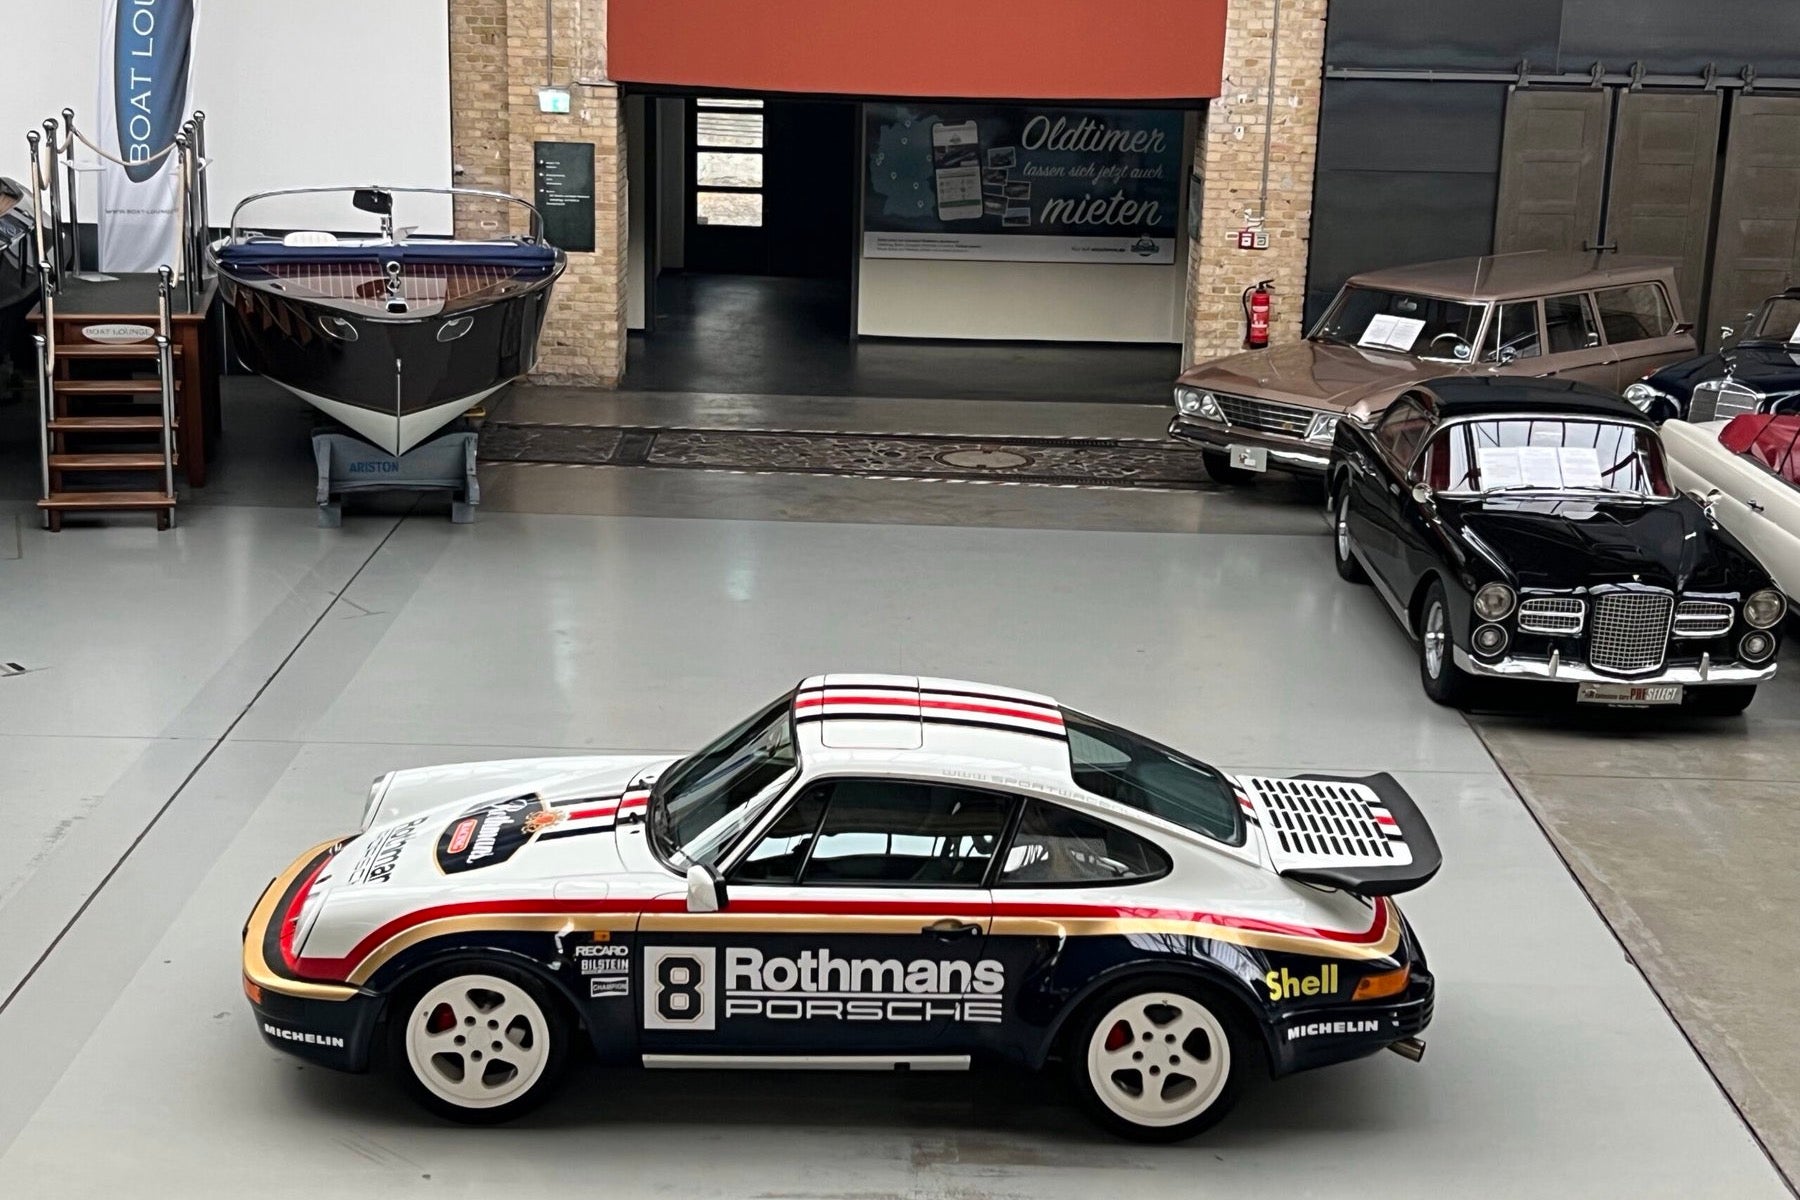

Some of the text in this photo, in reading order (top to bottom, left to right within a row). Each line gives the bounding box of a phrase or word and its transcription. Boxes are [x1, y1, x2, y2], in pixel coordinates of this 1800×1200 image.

[129, 67, 152, 164] BOAT
[1021, 115, 1166, 153] Oldtimer
[1023, 161, 1164, 185] lassen sich jetzt auch
[1040, 189, 1162, 226] mieten
[350, 461, 399, 473] ARISTON
[575, 945, 629, 957] RECARO
[581, 958, 629, 972] BILSTEIN
[656, 946, 1005, 1021] 8 Rothmans
[1266, 964, 1338, 1001] Shell
[725, 999, 1002, 1024] PORSCHE
[264, 1023, 344, 1048] MICHELIN
[1287, 1020, 1379, 1041] MICHELIN
